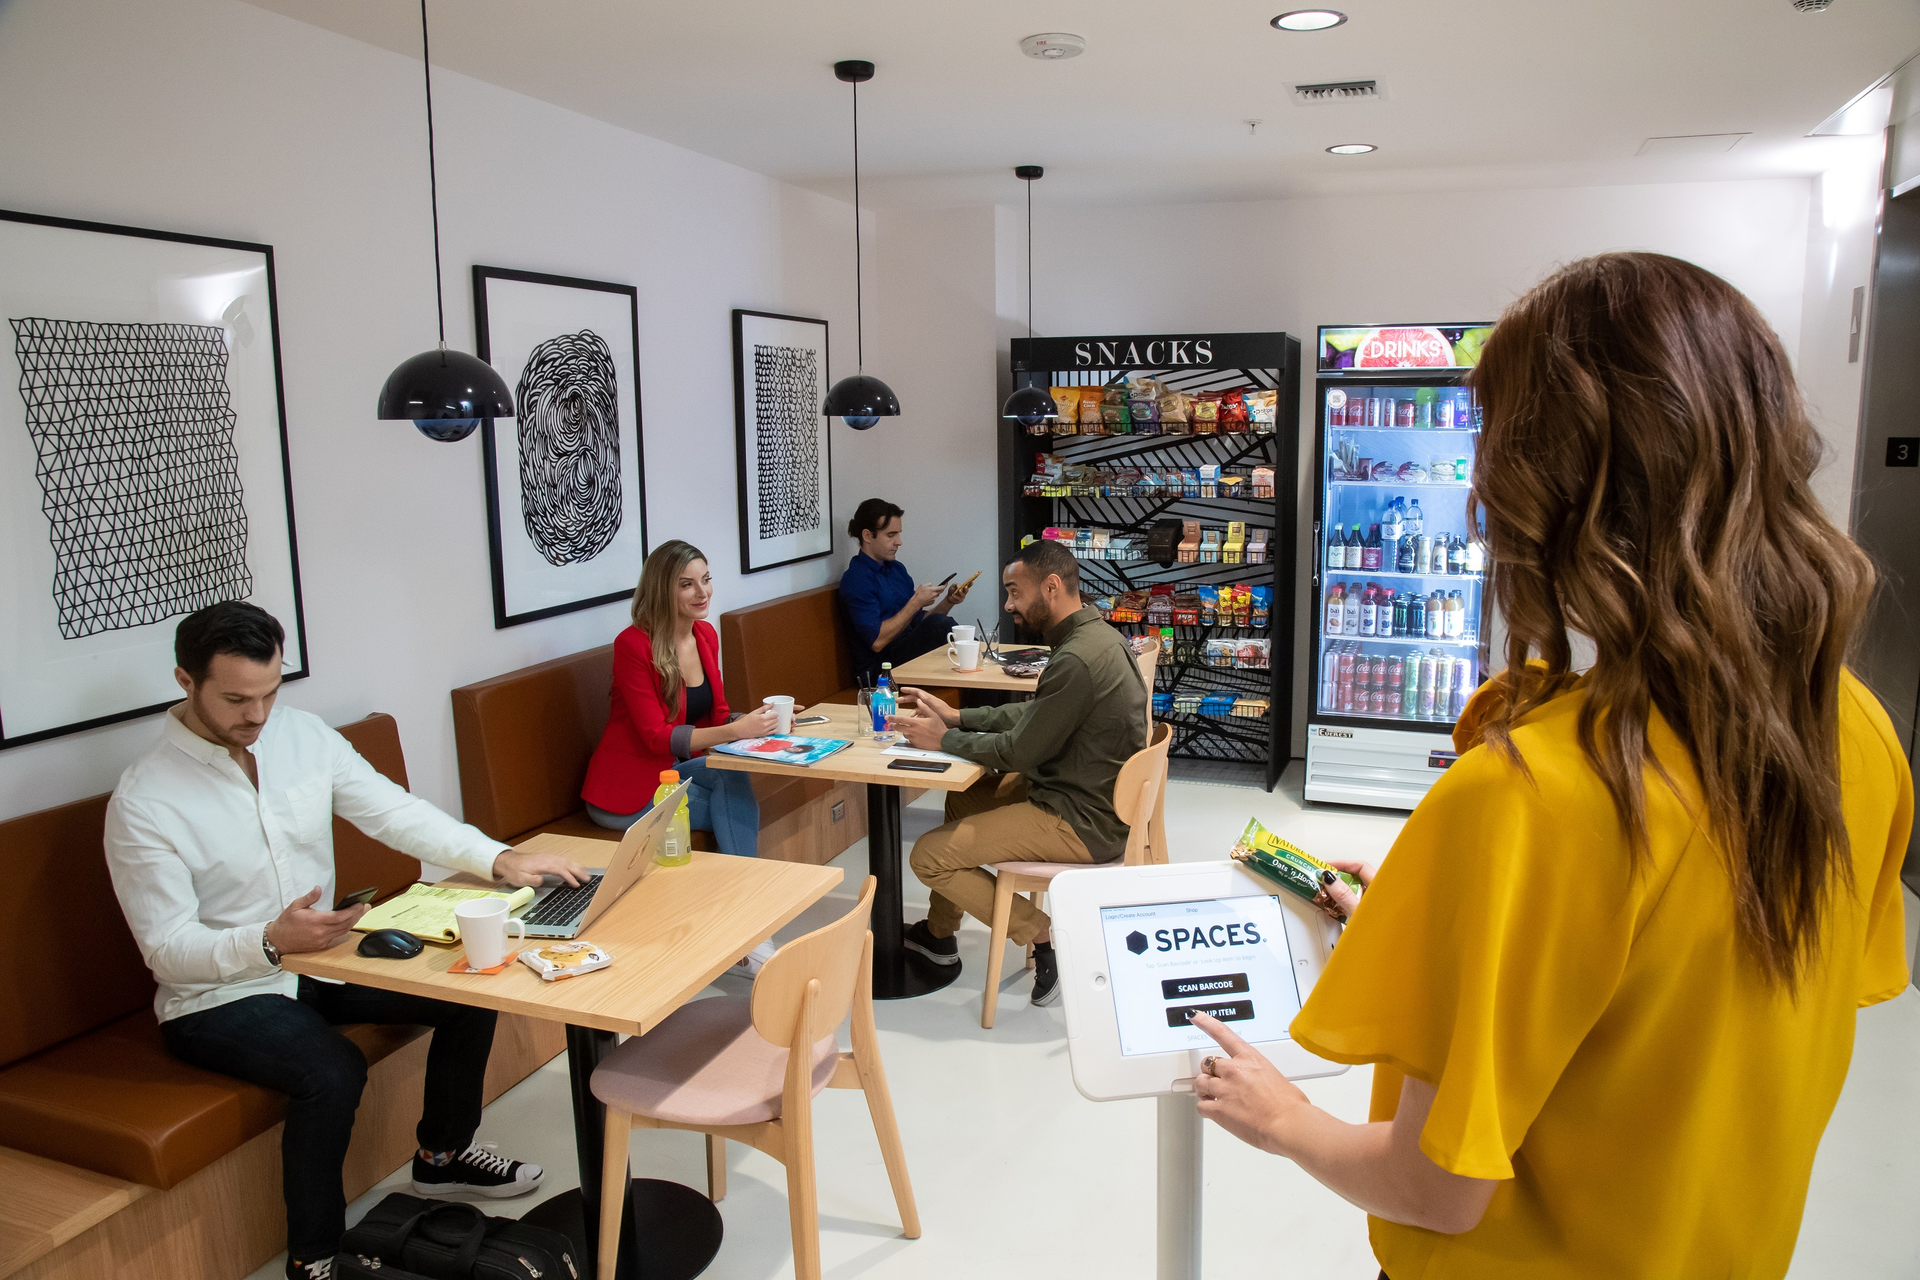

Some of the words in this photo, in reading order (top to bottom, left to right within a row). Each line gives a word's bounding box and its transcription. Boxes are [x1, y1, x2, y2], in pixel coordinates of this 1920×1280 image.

[1075, 340, 1213, 366] SNACKS
[1371, 340, 1441, 358] DRINKS
[1897, 444, 1909, 460] 3
[879, 704, 892, 716] FIJI
[1271, 835, 1306, 856] NATURE
[1307, 853, 1336, 871] VALLEY
[1285, 853, 1316, 874] CRUNCHY
[1272, 859, 1288, 872] Oats
[1296, 872, 1319, 891] Honey
[1178, 983, 1198, 992] SCAN
[1199, 980, 1234, 991] BARCODE
[1218, 1008, 1236, 1017] ITEM
